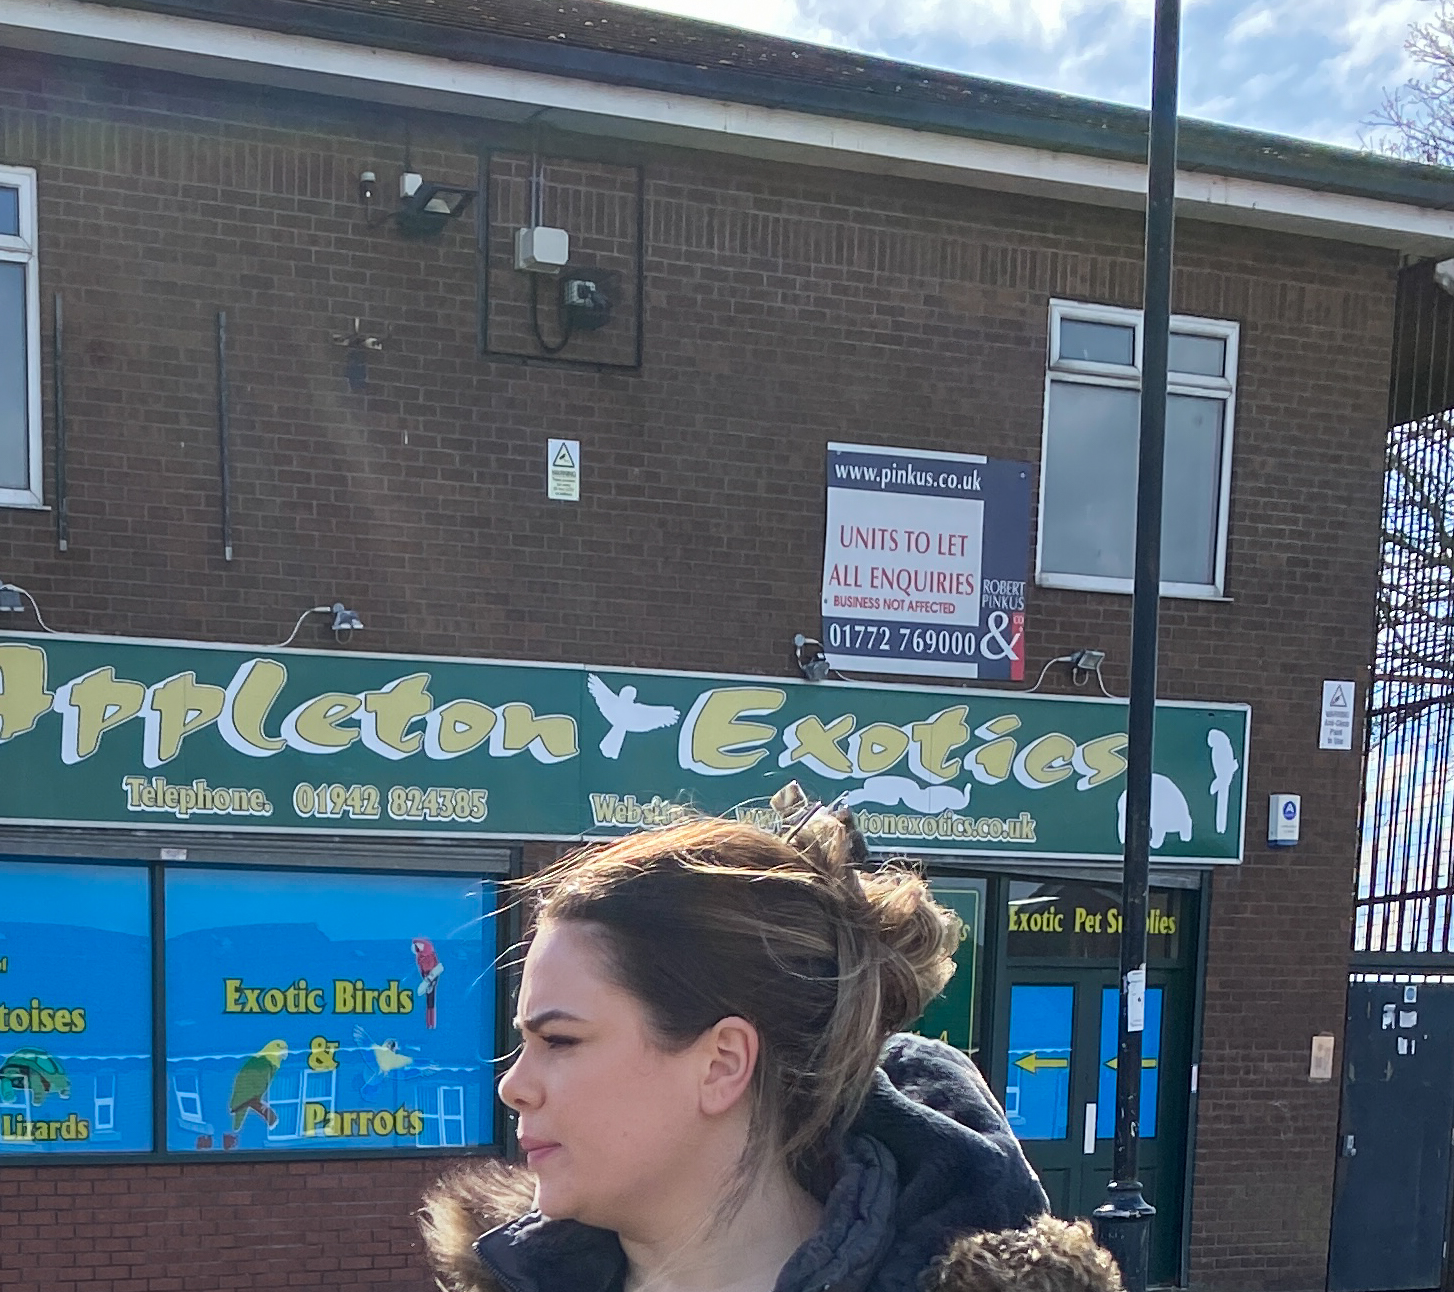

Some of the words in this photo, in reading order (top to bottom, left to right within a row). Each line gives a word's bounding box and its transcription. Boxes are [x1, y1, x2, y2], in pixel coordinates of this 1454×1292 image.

[834, 462, 982, 491] www.pinkus.co.uk
[840, 524, 899, 552] UNITS
[904, 530, 930, 554] TO
[937, 533, 968, 557] LET
[828, 563, 862, 589] ALL
[870, 566, 975, 597] ENQUIRIES
[983, 579, 1026, 596] ROBERT
[833, 596, 880, 610] BUSINESS
[883, 598, 905, 611] NOT
[907, 600, 956, 615] AFFECTED
[982, 594, 1025, 611] PINKUS
[829, 622, 891, 651] 01772
[899, 628, 976, 656] 769000
[980, 610, 1020, 660] &
[678, 686, 1128, 790] Exotics
[123, 775, 274, 819] Telephone.
[293, 782, 380, 820] 01942
[388, 786, 489, 822] 824385
[1008, 905, 1064, 933] Exotic
[1074, 907, 1103, 933] Pet
[223, 978, 325, 1015] Exotic
[333, 979, 414, 1015] Birds
[308, 1036, 339, 1072] &
[1, 1113, 89, 1141] Lizards
[303, 1103, 424, 1138] Parrots
